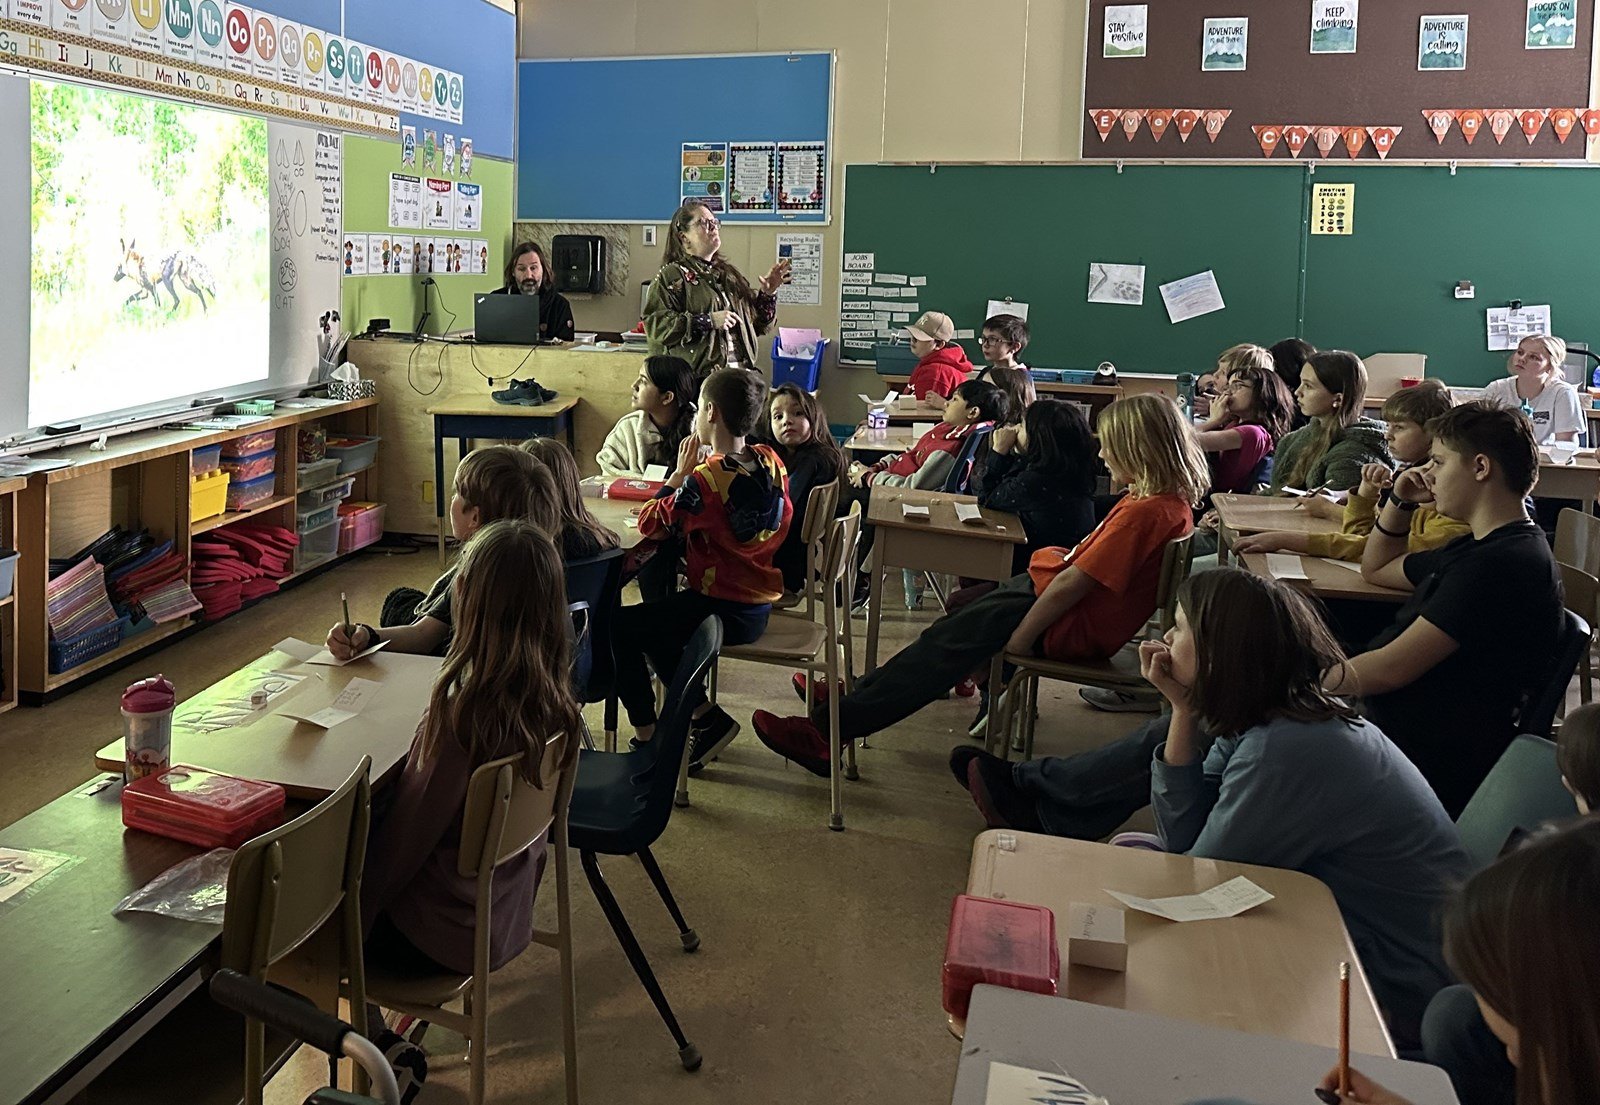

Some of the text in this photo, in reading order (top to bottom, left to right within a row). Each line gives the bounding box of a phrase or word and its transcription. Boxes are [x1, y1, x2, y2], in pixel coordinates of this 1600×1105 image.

[17, 11, 30, 19] every
[20, 2, 42, 12] IMPROVE
[169, 0, 191, 29] Mm
[1325, 7, 1344, 17] KEEP
[1534, 2, 1570, 12] FOCUS ON
[63, 21, 80, 30] JOYFUL
[202, 8, 221, 36] Nn
[230, 16, 248, 44] Oo
[1108, 22, 1126, 33] STAY
[1316, 18, 1353, 29] climbing
[1424, 21, 1464, 31] ADVENTURE
[1111, 31, 1144, 43] positive
[1208, 27, 1243, 36] ADVENTURE
[258, 22, 273, 58] Pp
[282, 32, 297, 61] Qq
[1427, 40, 1458, 52] calling
[308, 40, 320, 62] Rr
[330, 46, 343, 70] Ss
[351, 54, 361, 76] Tt
[369, 58, 381, 81] Uu
[0, 32, 397, 130] Gg Hh Ii Jj Kk Ll Mm Nn Oo Pp Qq Rr Ss Tt Uu Vv Ww Xx Yy Zz
[388, 64, 399, 85] Vv
[405, 70, 416, 89] Ww
[421, 74, 431, 93] Xx
[437, 80, 446, 102] Yy
[452, 84, 460, 102] Zz
[1100, 116, 1216, 129] Every
[1263, 132, 1388, 146] Child
[315, 162, 327, 170] Morning
[275, 294, 294, 309] CAT
